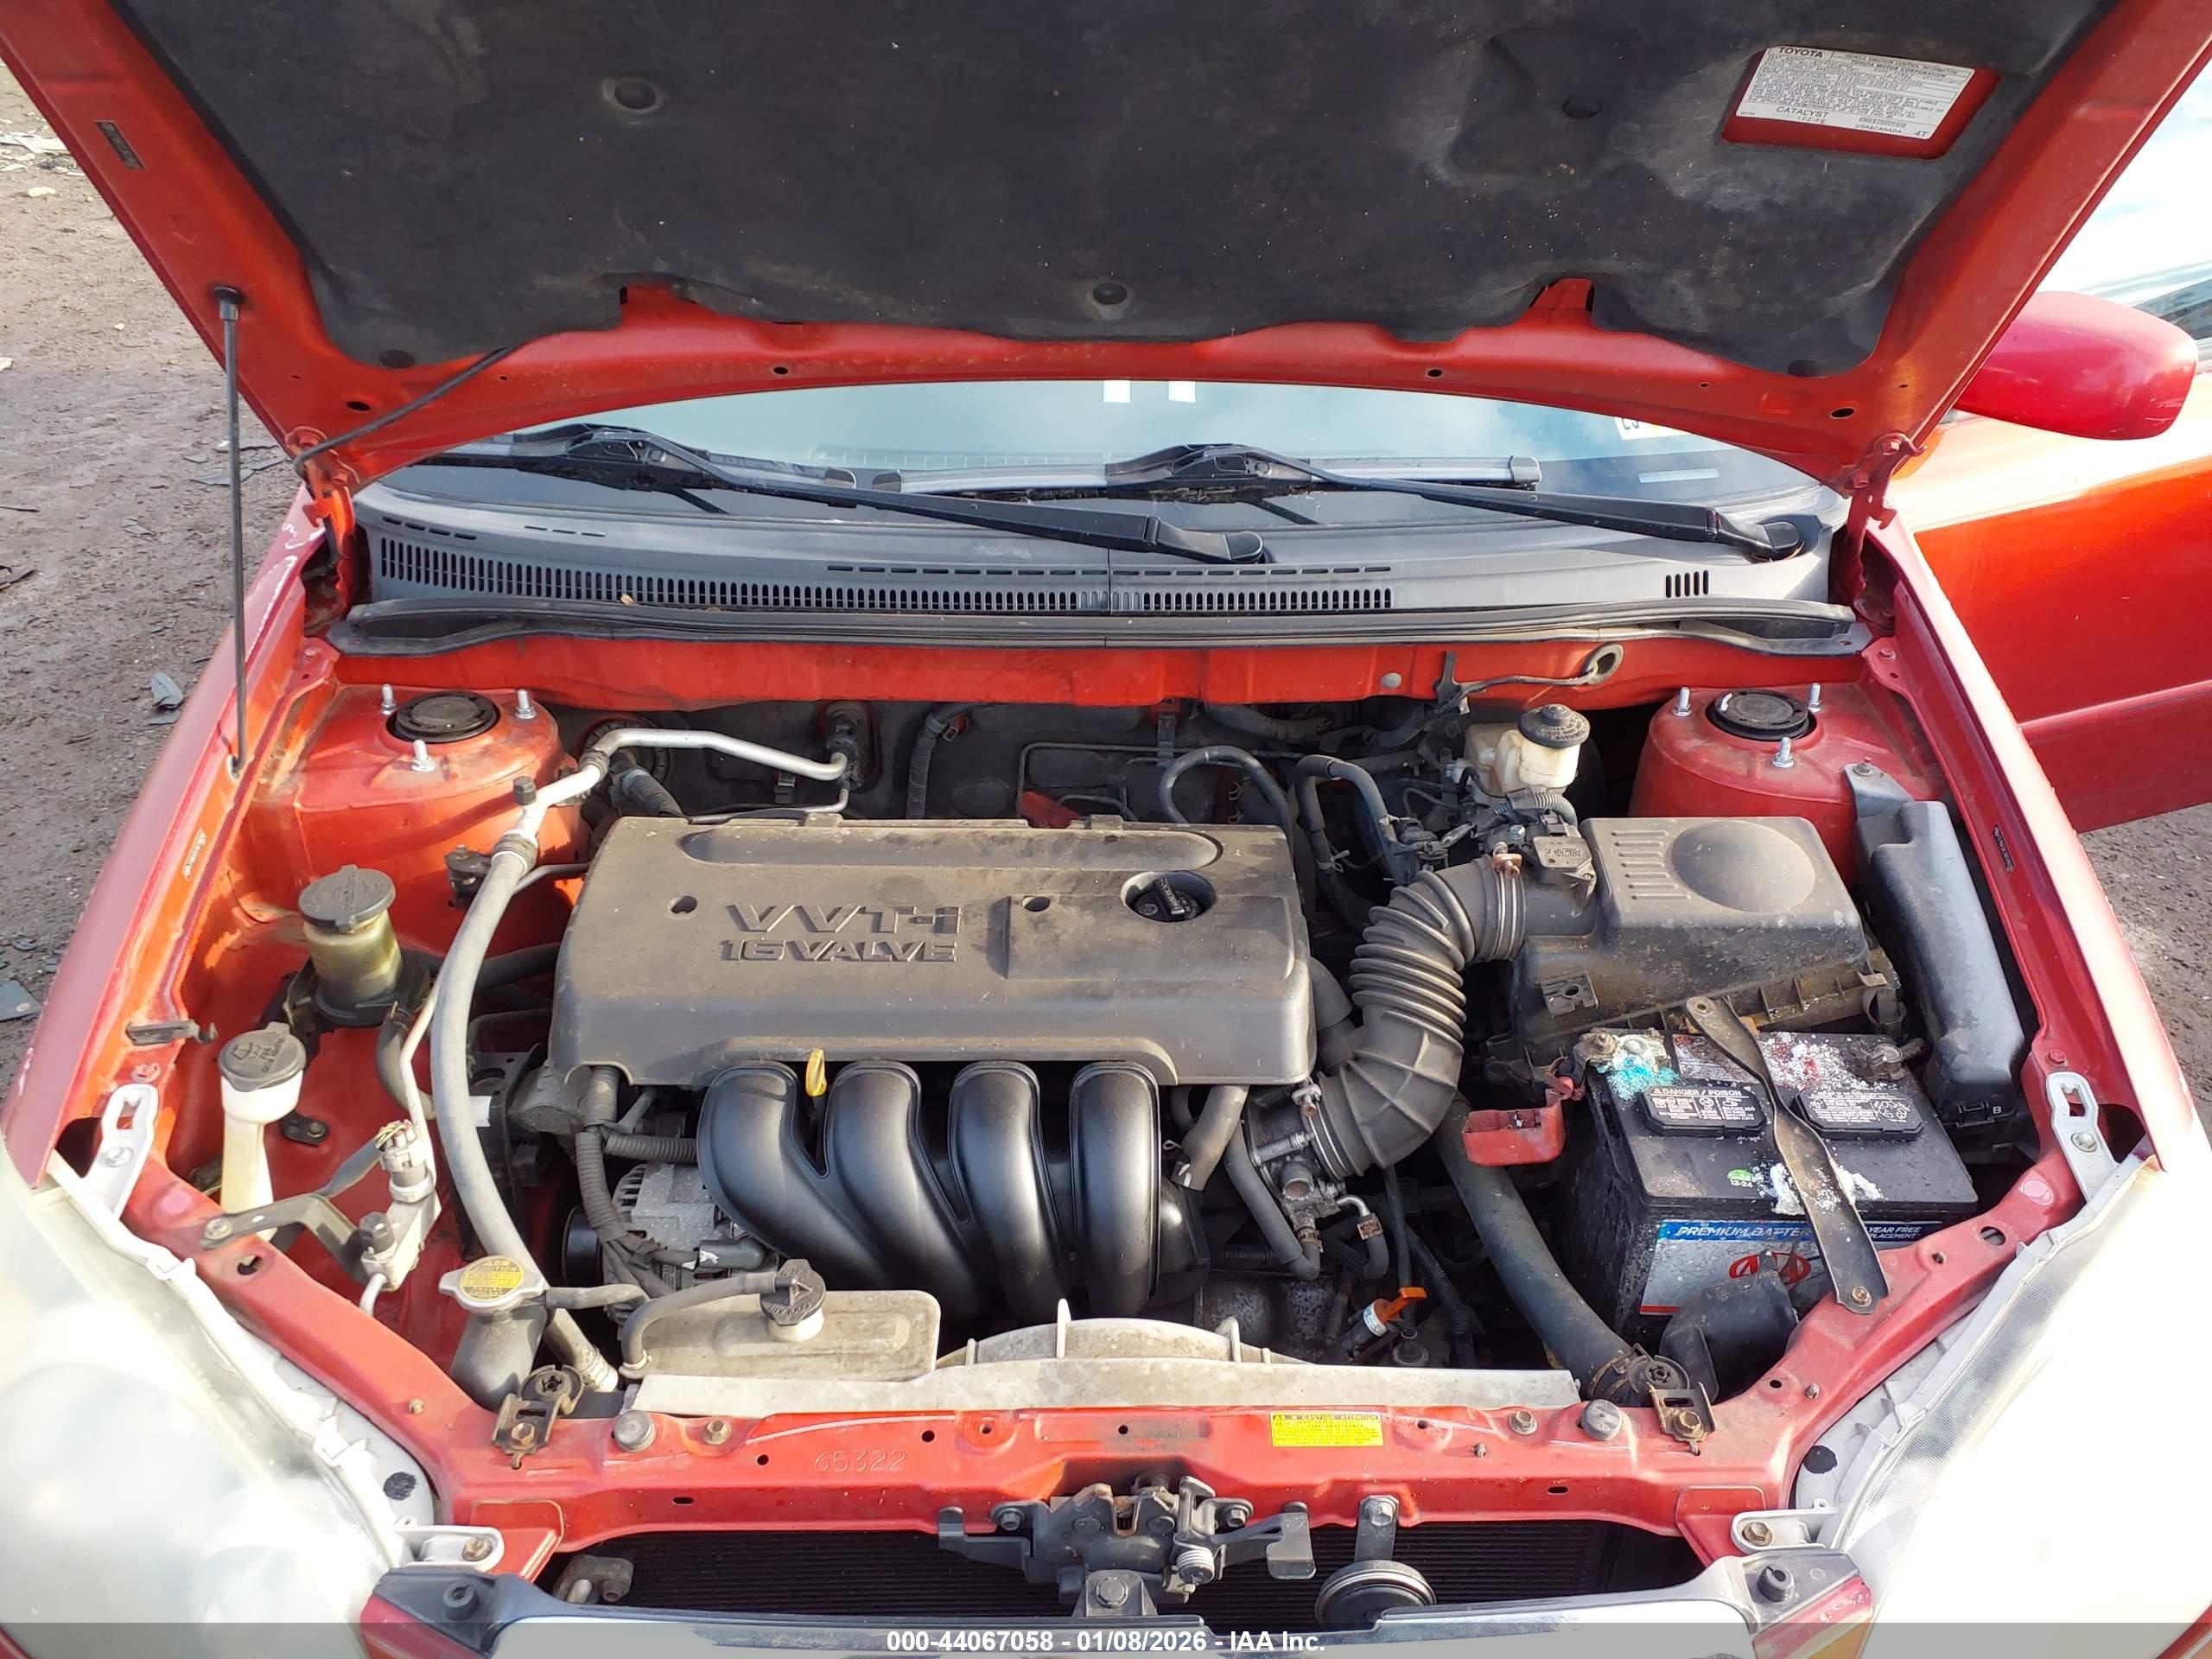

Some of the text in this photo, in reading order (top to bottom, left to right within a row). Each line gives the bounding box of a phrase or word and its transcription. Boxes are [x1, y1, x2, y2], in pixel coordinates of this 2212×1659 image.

[1779, 47, 1823, 58] TOYOTA
[1900, 66, 1946, 78] CORPORATION
[1777, 105, 1829, 118] CATALYST
[1676, 1226, 1812, 1237] PREMIUM BATTER
[814, 1450, 906, 1472] 65322
